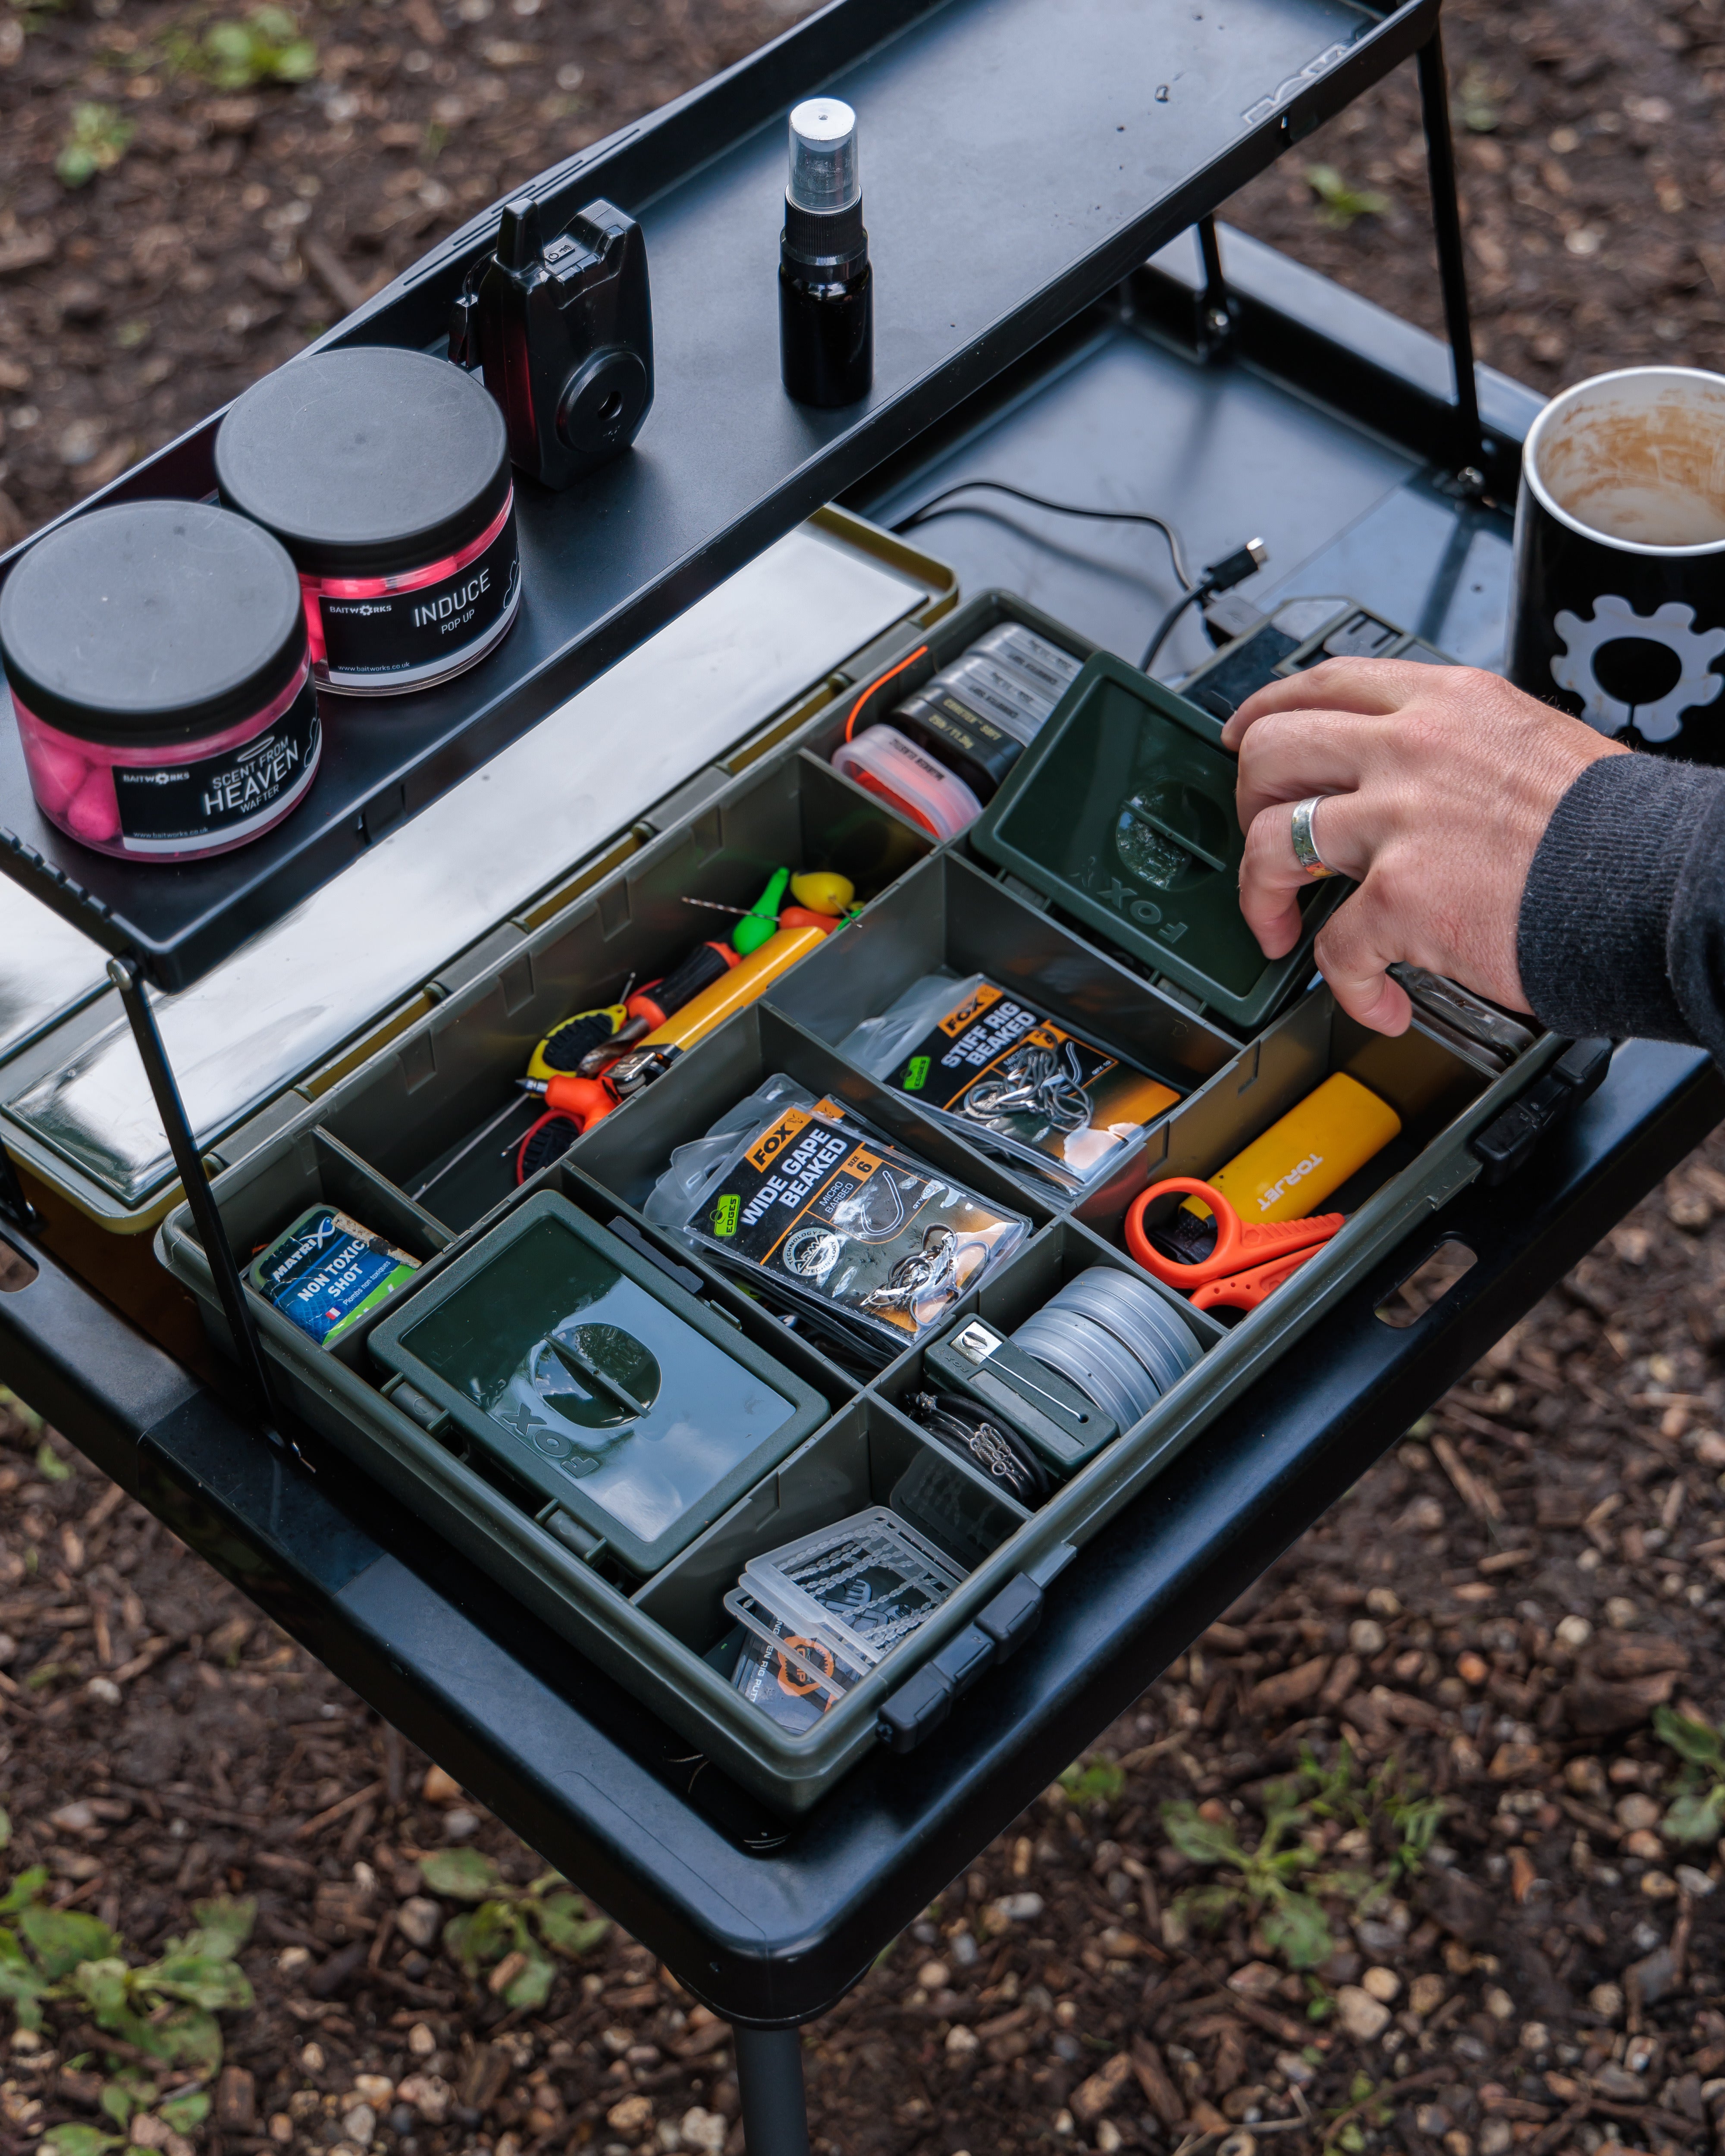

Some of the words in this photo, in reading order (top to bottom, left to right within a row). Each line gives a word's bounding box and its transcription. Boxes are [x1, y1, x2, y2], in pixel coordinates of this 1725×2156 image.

[413, 568, 491, 628] INDUCE
[441, 618, 461, 635] POP
[463, 609, 475, 624] UP
[337, 661, 411, 673] www.baitworks.co.uk
[204, 739, 300, 816] HEAVEN
[212, 761, 256, 790] SCENT
[258, 736, 290, 768] FROM
[239, 783, 280, 814] WAFTER
[133, 825, 209, 839] www.baitworks.co.uk
[1098, 877, 1189, 945] FOX
[946, 996, 985, 1032] FOX
[941, 1025, 990, 1069] STIFF
[983, 1001, 1021, 1028] RIG
[964, 1011, 1037, 1068] BEAKED
[754, 1122, 795, 1167] FOX
[847, 1155, 859, 1167] SIZE
[739, 1174, 779, 1227] WIDE
[781, 1128, 831, 1176] GAPE
[778, 1138, 848, 1209] BEAKED
[856, 1161, 872, 1173] 6
[1257, 1153, 1324, 1212] TORJET
[819, 1181, 844, 1207] MICRO
[824, 1182, 854, 1214] BARBED
[913, 1197, 924, 1210] QTY
[923, 1188, 931, 1197] 10
[726, 1197, 736, 1234] EDGES
[273, 1216, 336, 1283] MATRIX
[786, 1231, 817, 1265] TECHNOLOGY
[806, 1241, 837, 1272] TECHNOLOGY
[297, 1273, 330, 1302] NON
[325, 1238, 367, 1277] TOXIC
[327, 1263, 364, 1298] SHOT
[342, 1287, 364, 1307] Plombs
[361, 1279, 372, 1290] non
[369, 1260, 391, 1283] toxiques
[944, 1355, 969, 1373] FOX
[501, 1403, 600, 1479] FOX
[757, 1661, 768, 1677] RIG
